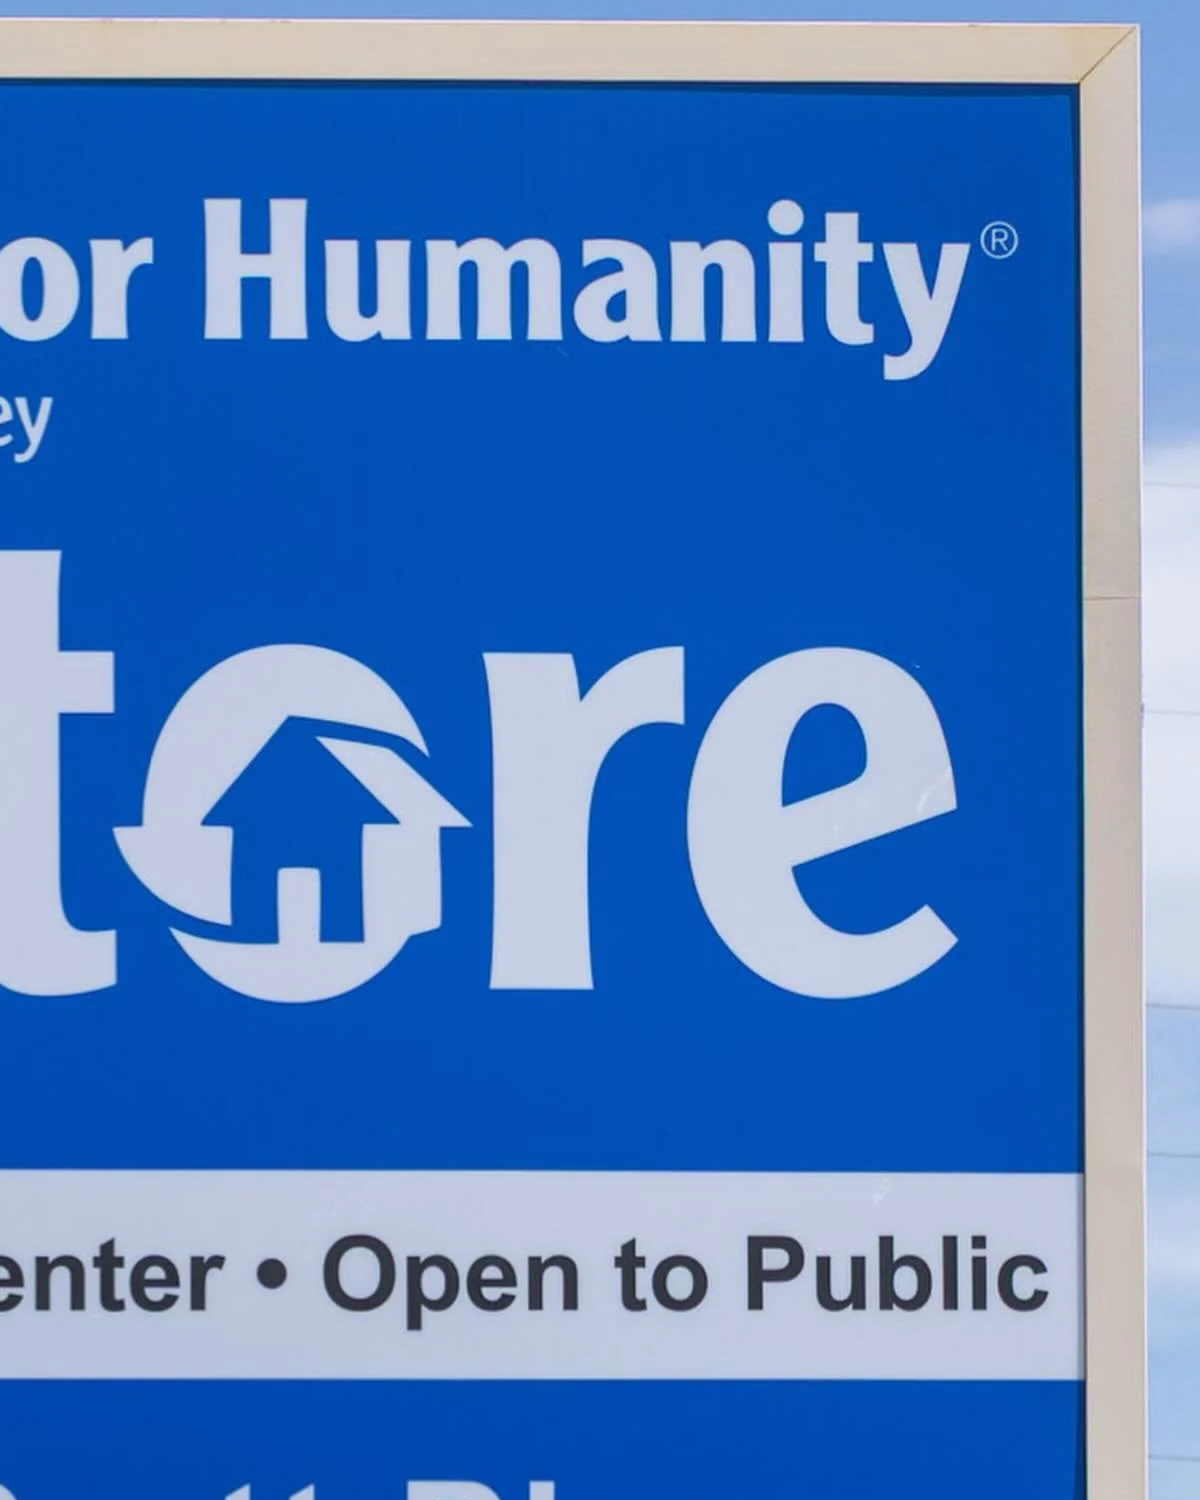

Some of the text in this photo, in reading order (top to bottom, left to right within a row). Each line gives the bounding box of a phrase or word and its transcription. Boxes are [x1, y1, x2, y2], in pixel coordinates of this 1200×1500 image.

[322, 1234, 579, 1332] Open
[613, 1237, 709, 1313] to
[746, 1234, 1049, 1313] Public
